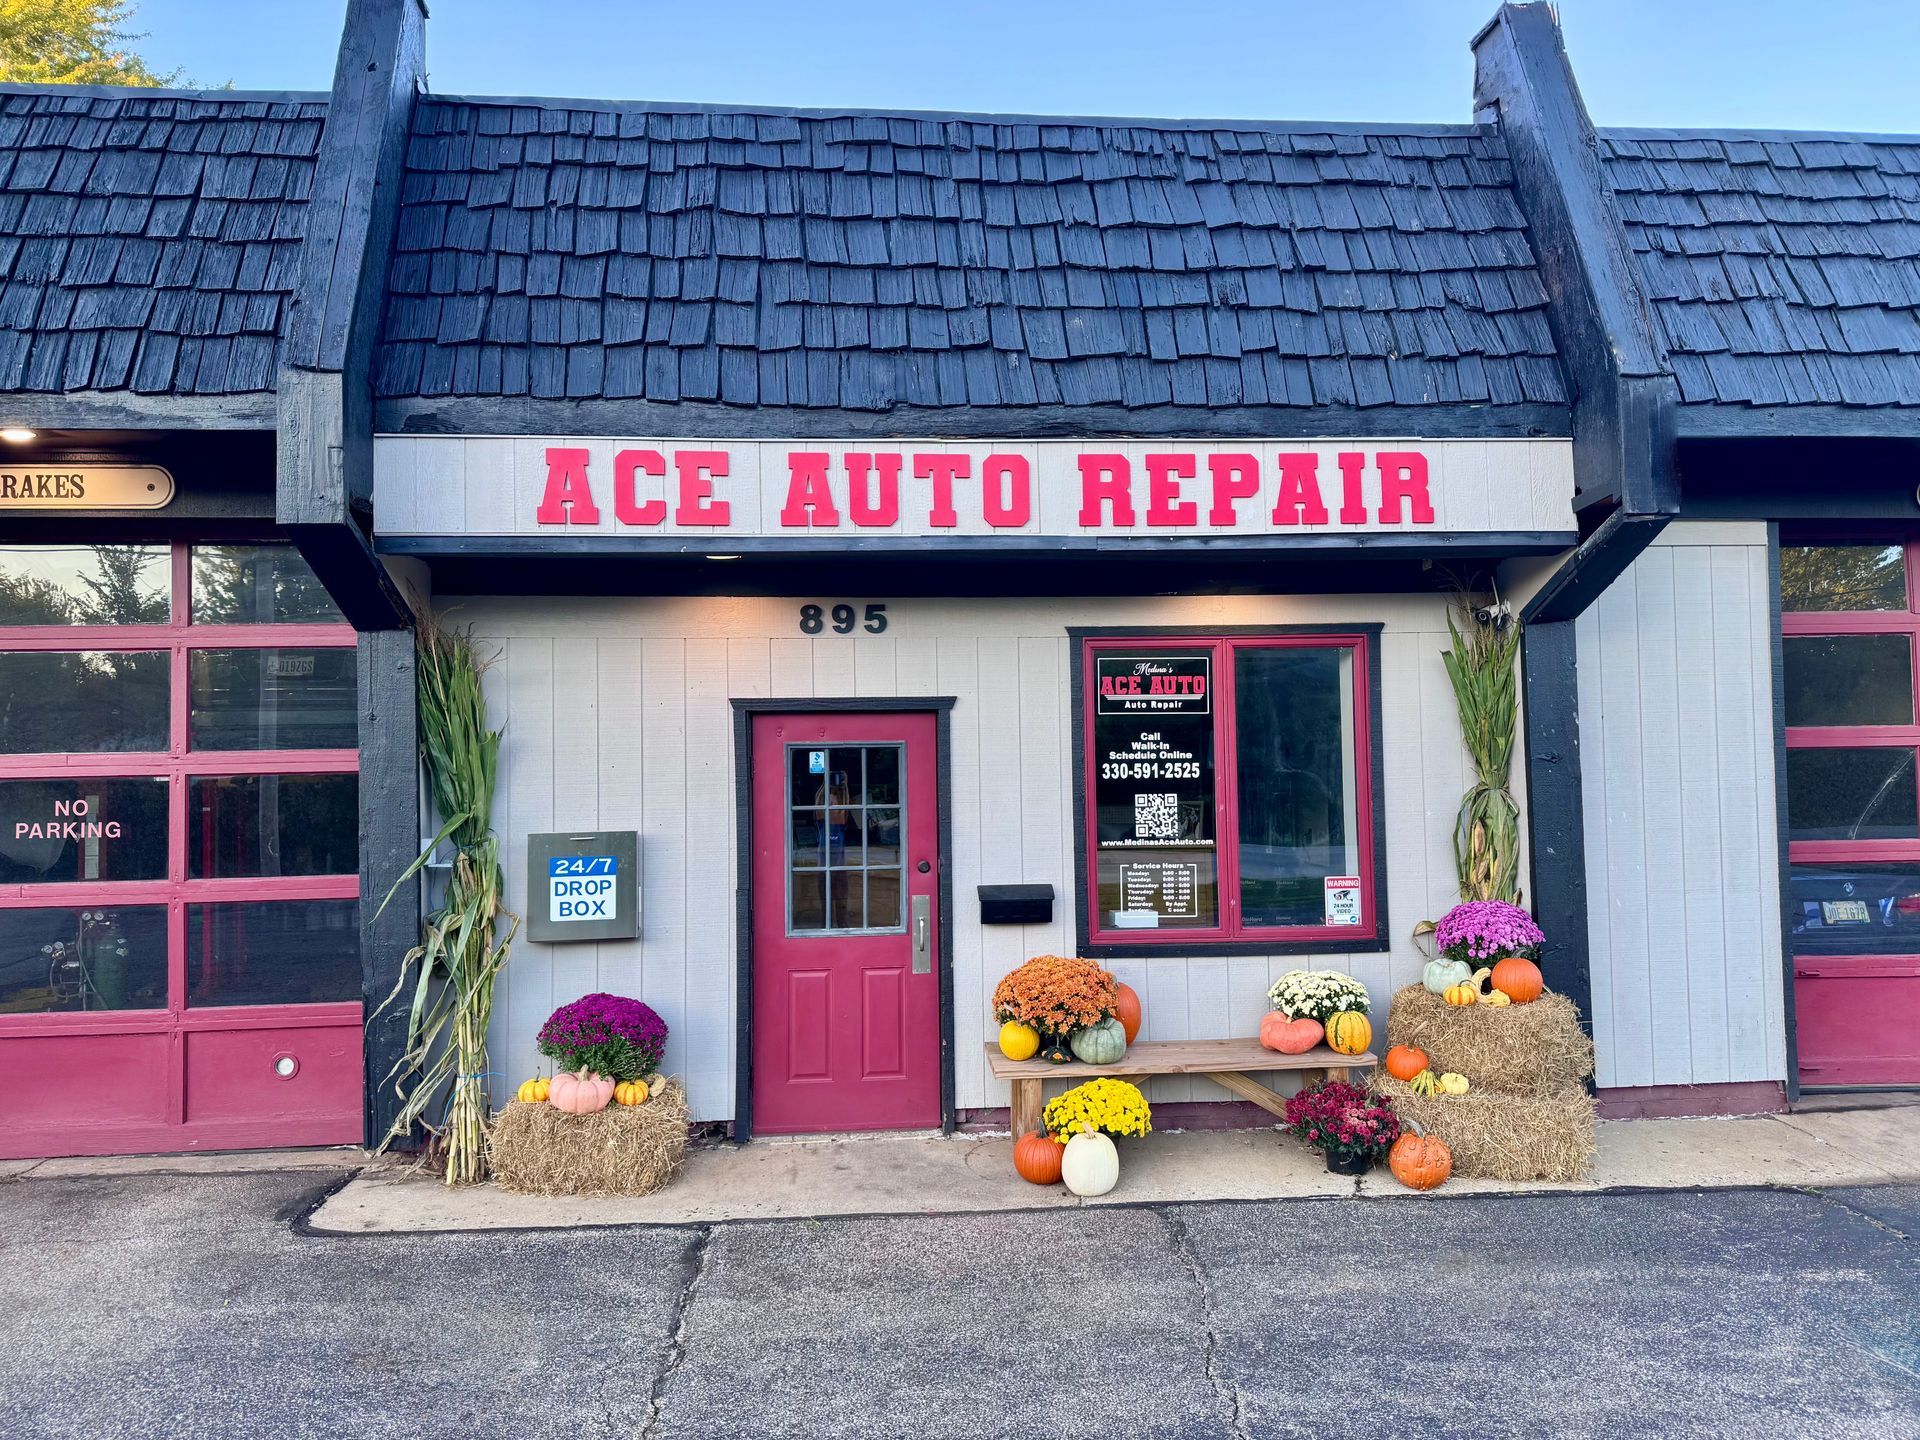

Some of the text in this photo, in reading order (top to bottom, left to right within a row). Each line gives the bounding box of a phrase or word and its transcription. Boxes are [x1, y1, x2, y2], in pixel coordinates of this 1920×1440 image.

[0, 474, 85, 499] RAKES
[537, 448, 1435, 528] ACE AUTO REPAIR
[799, 604, 888, 635] 895
[1133, 662, 1173, 676] Medina's
[1100, 675, 1206, 695] ACE AUTO
[1124, 701, 1183, 710] Auto Repair
[1140, 732, 1161, 741] Call
[1131, 742, 1170, 750] Walk-In
[1109, 751, 1193, 760] Schedule Online
[1102, 762, 1200, 779] 330-591-2525
[54, 799, 89, 817] NO
[15, 821, 121, 839] PARKING
[1101, 838, 1214, 847] www.MedinasAceAuto.com
[555, 858, 612, 874] 24/7
[554, 880, 612, 896] DROP
[1327, 879, 1359, 887] WARNING
[559, 900, 606, 917] BOX
